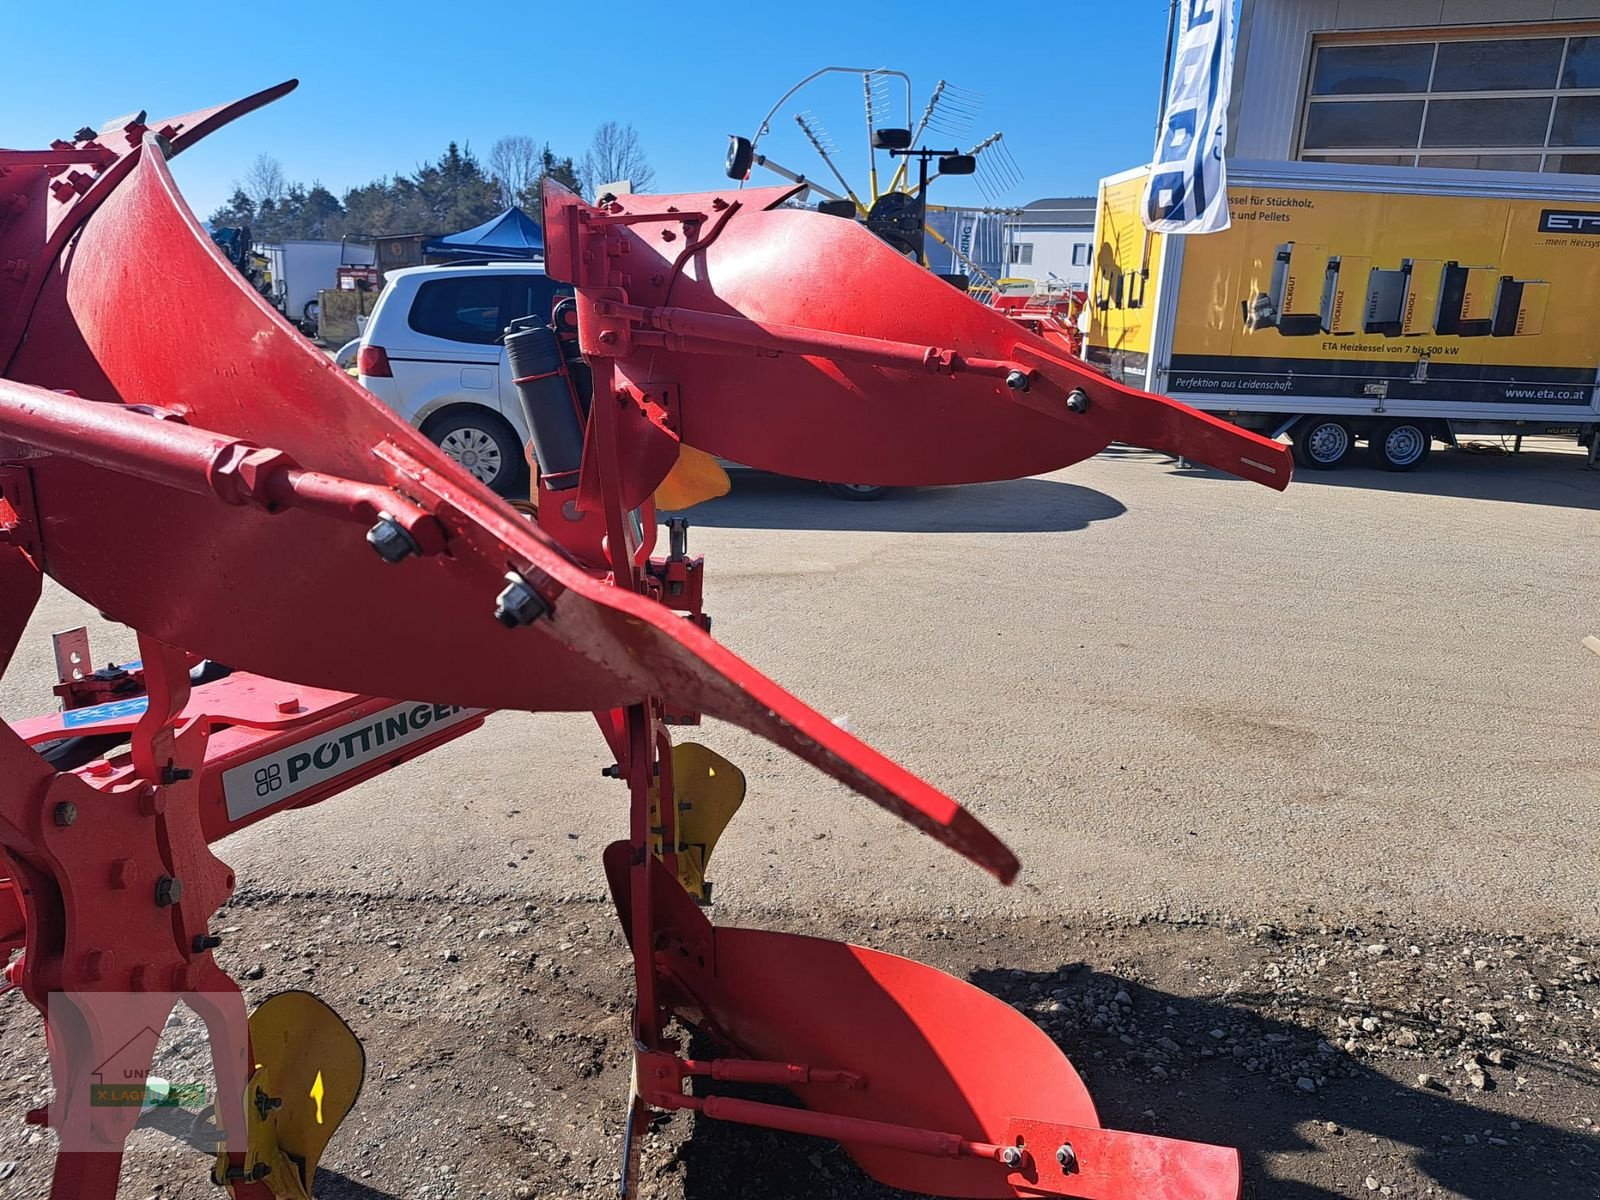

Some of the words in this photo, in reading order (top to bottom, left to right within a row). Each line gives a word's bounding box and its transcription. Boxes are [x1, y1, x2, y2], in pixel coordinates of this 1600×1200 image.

[1227, 195, 1248, 205] ssel
[1250, 195, 1265, 206] für
[1266, 196, 1315, 209] Stückholz,
[1237, 210, 1257, 220] und
[1258, 211, 1291, 222] Pellets
[1284, 275, 1296, 313] HACKGUT
[1369, 290, 1380, 319] PELLETS
[1463, 292, 1472, 318] PELLETS
[1517, 308, 1526, 334] PELLETS
[1321, 342, 1338, 351] ETA
[1339, 343, 1385, 353] Heizkessel
[1386, 345, 1403, 353] von
[1404, 345, 1411, 354] 7
[1412, 345, 1424, 354] bis
[1426, 346, 1443, 355] 500
[1444, 346, 1460, 355] kW
[1175, 377, 1219, 389] Perfektion
[1221, 379, 1236, 388] aus
[1238, 379, 1294, 391] Leidenschaft.
[1505, 389, 1584, 400] www.eta.co.at
